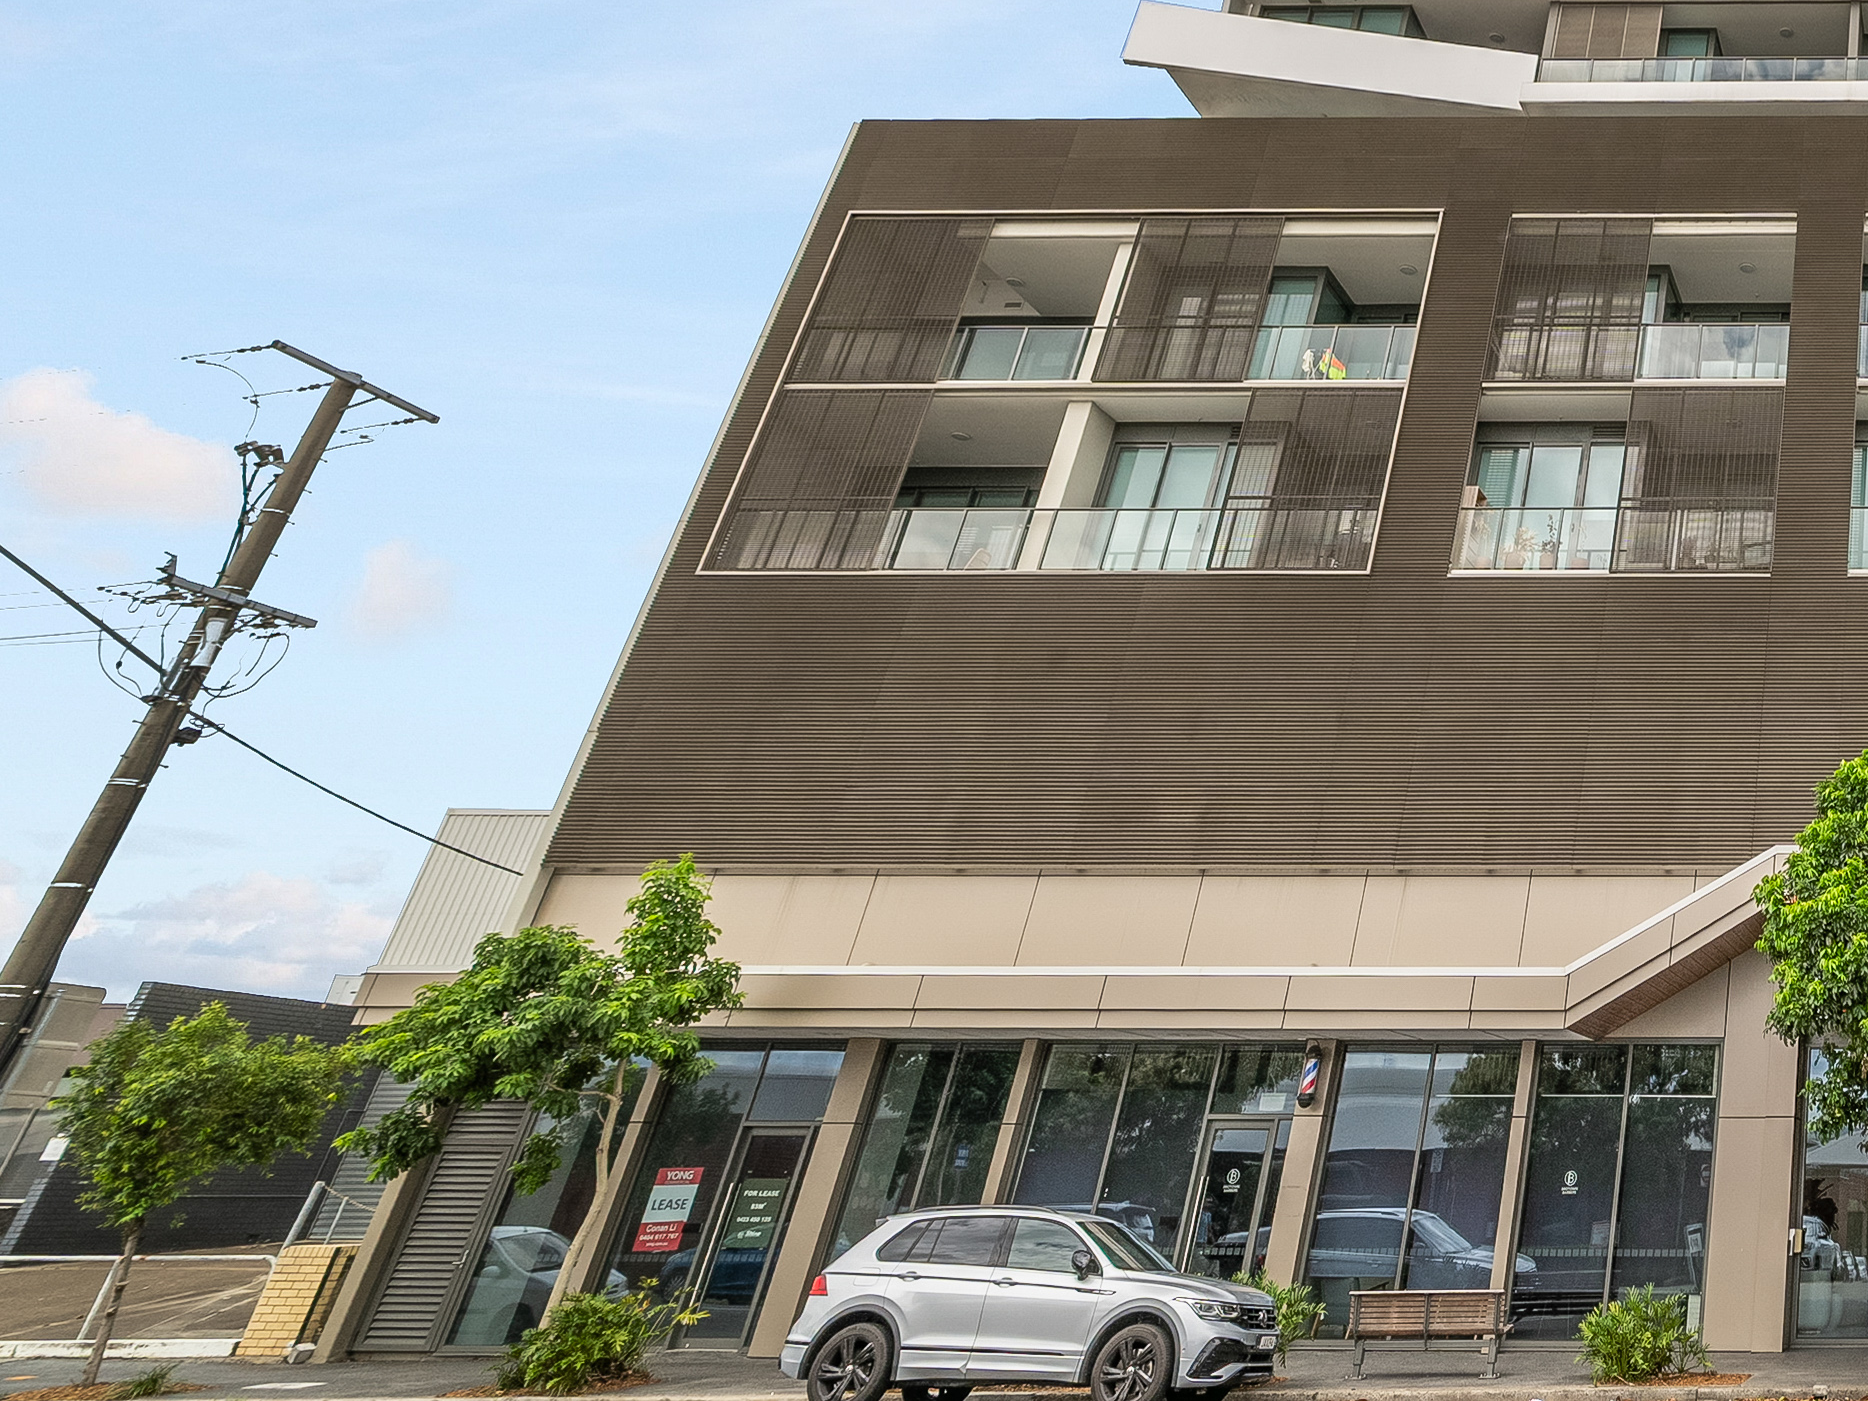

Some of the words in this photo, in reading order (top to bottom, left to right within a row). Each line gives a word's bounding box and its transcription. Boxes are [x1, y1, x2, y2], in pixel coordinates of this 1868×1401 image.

[667, 1170, 694, 1181] YONG
[651, 1198, 689, 1210] LEASE
[646, 1224, 668, 1232] Conan
